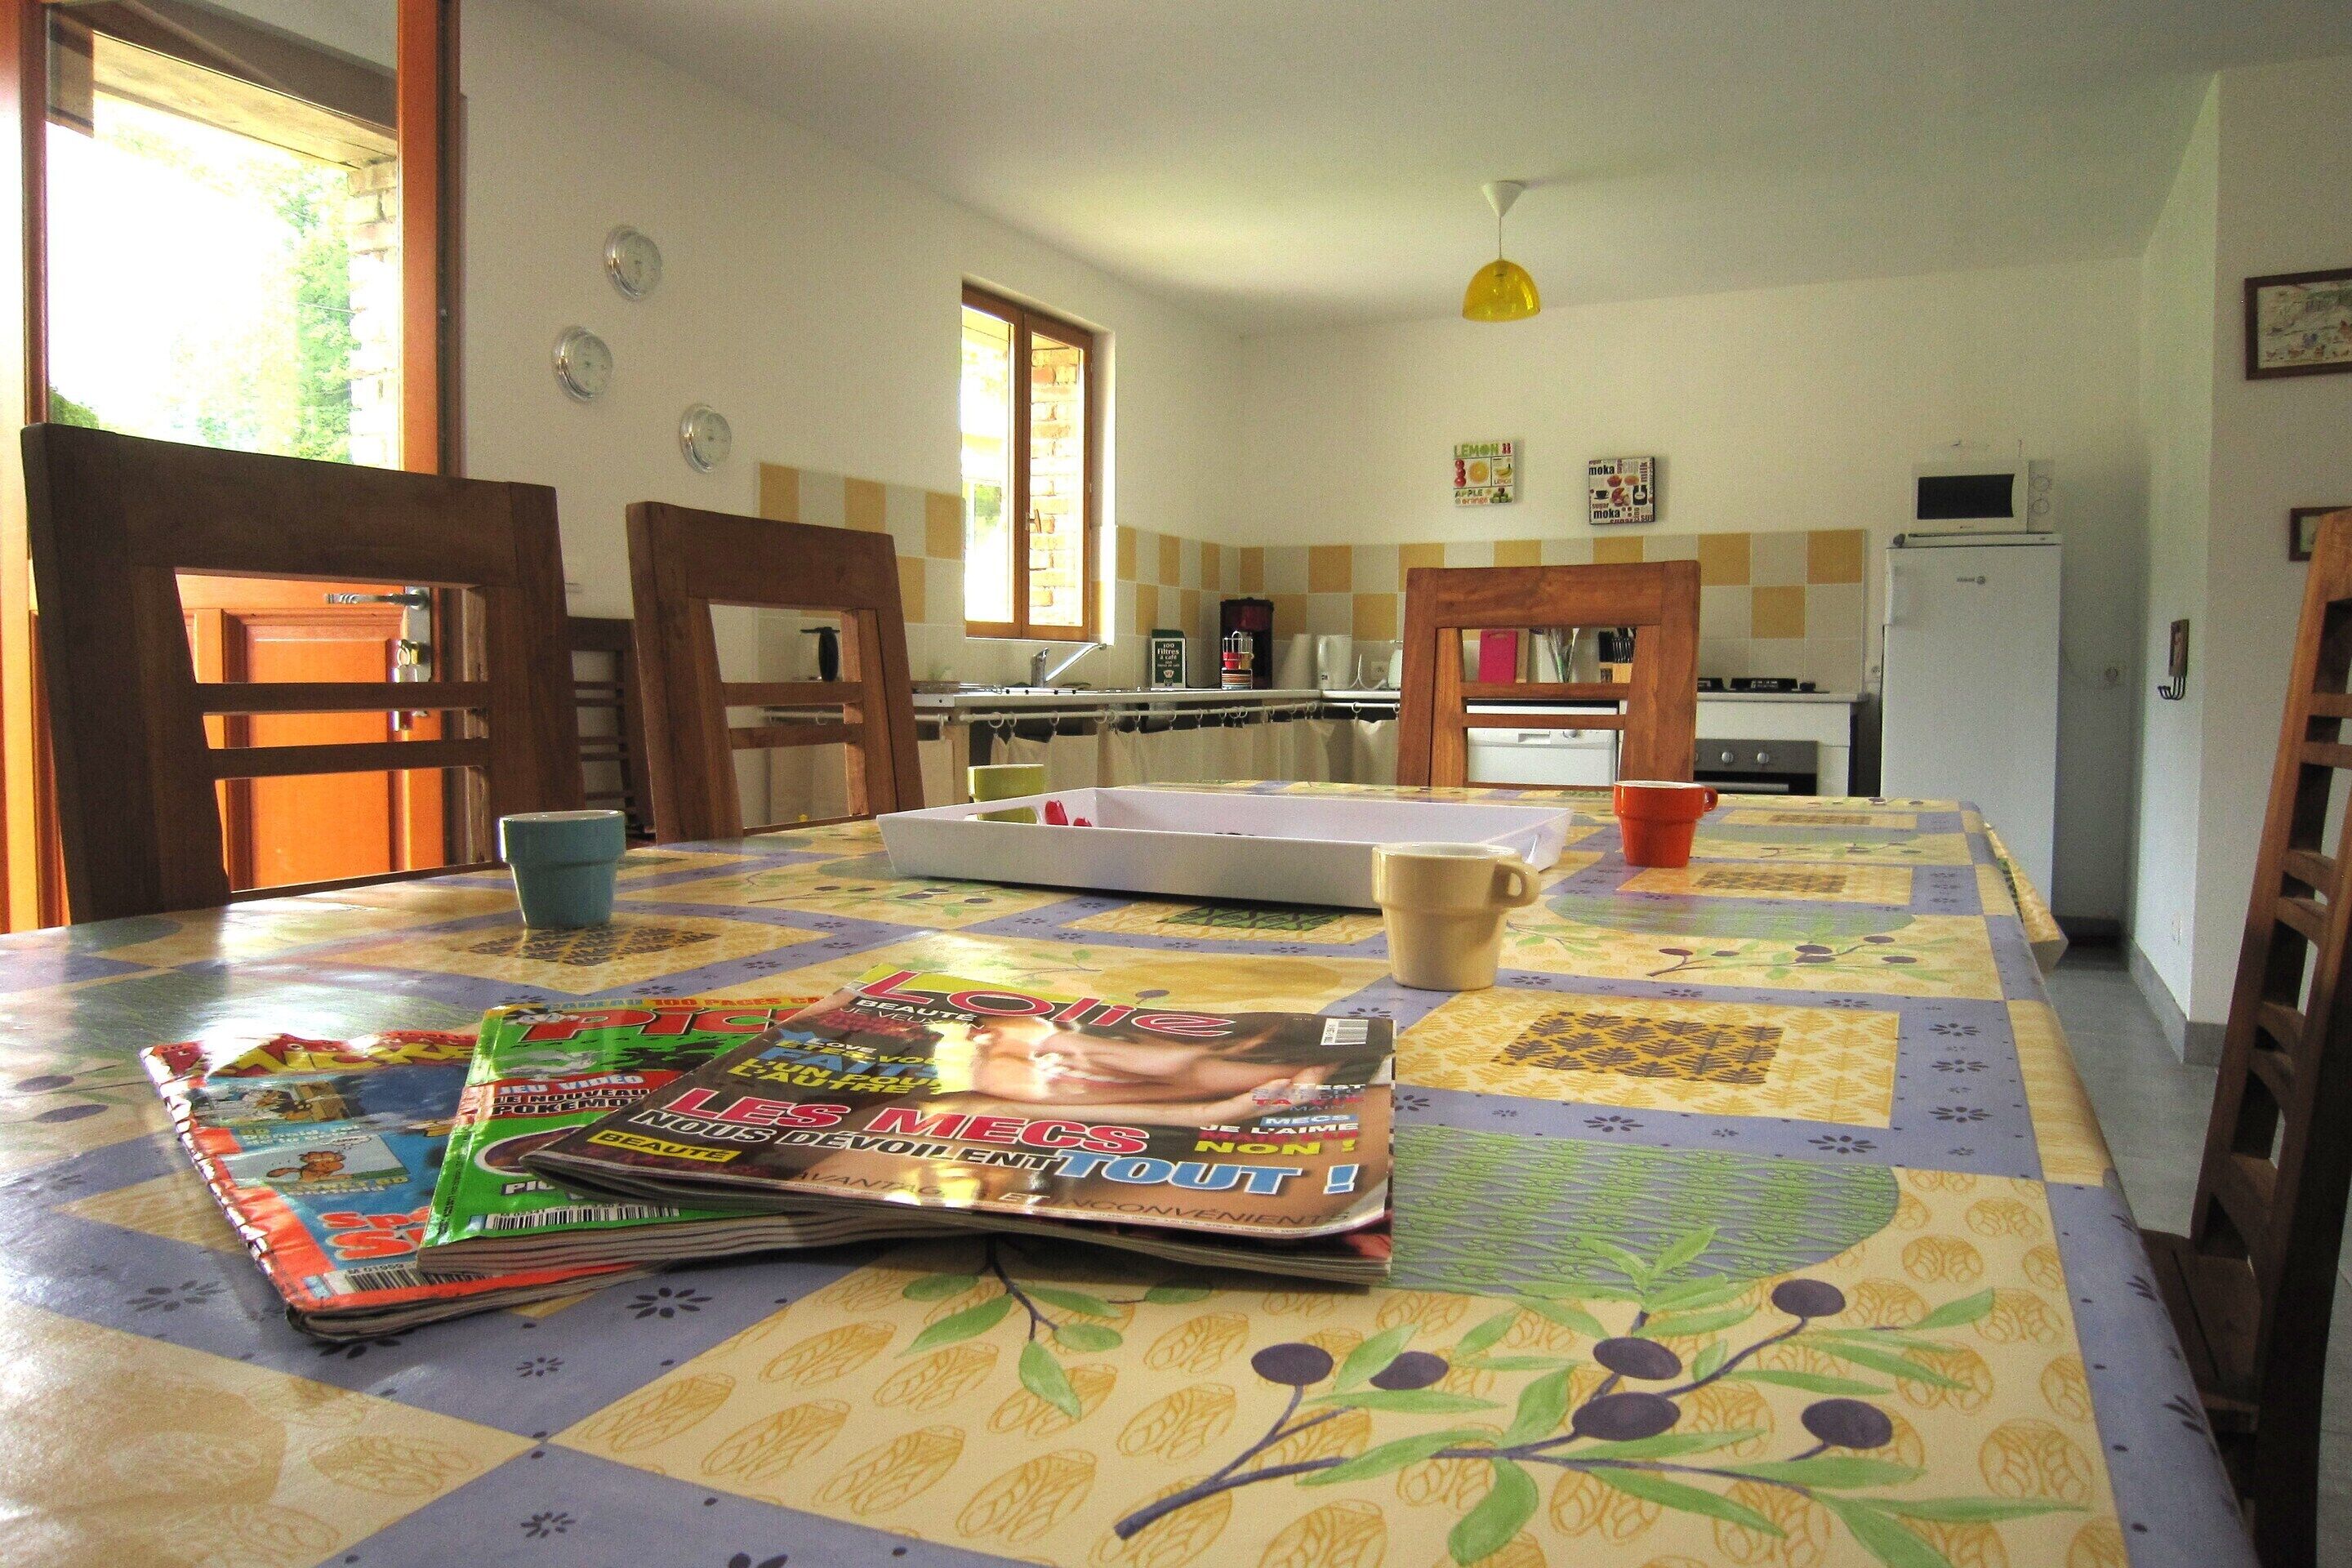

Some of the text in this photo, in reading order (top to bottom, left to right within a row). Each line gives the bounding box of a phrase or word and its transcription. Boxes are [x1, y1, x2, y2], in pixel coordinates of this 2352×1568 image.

[1454, 443, 1499, 457] LEMON
[1588, 465, 1615, 474] moka
[1639, 461, 1648, 482] milk
[1593, 508, 1620, 519] moka
[857, 999, 977, 1022] BEAUTÉ
[804, 1037, 876, 1054] LOVE
[739, 1058, 835, 1078] L'UN
[726, 1064, 917, 1094] L'AUTRE
[528, 1088, 652, 1104] NOUVEAU
[661, 1088, 1150, 1154] LES MECS
[1266, 1115, 1352, 1125] MECS
[1200, 1123, 1359, 1134] JE L'AIME
[628, 1109, 777, 1142] NOUS
[775, 1130, 1060, 1172] DÉVOILENT
[1055, 1149, 1303, 1196] TOUT
[1323, 1164, 1359, 1195] !
[1194, 1139, 1356, 1155] NON !
